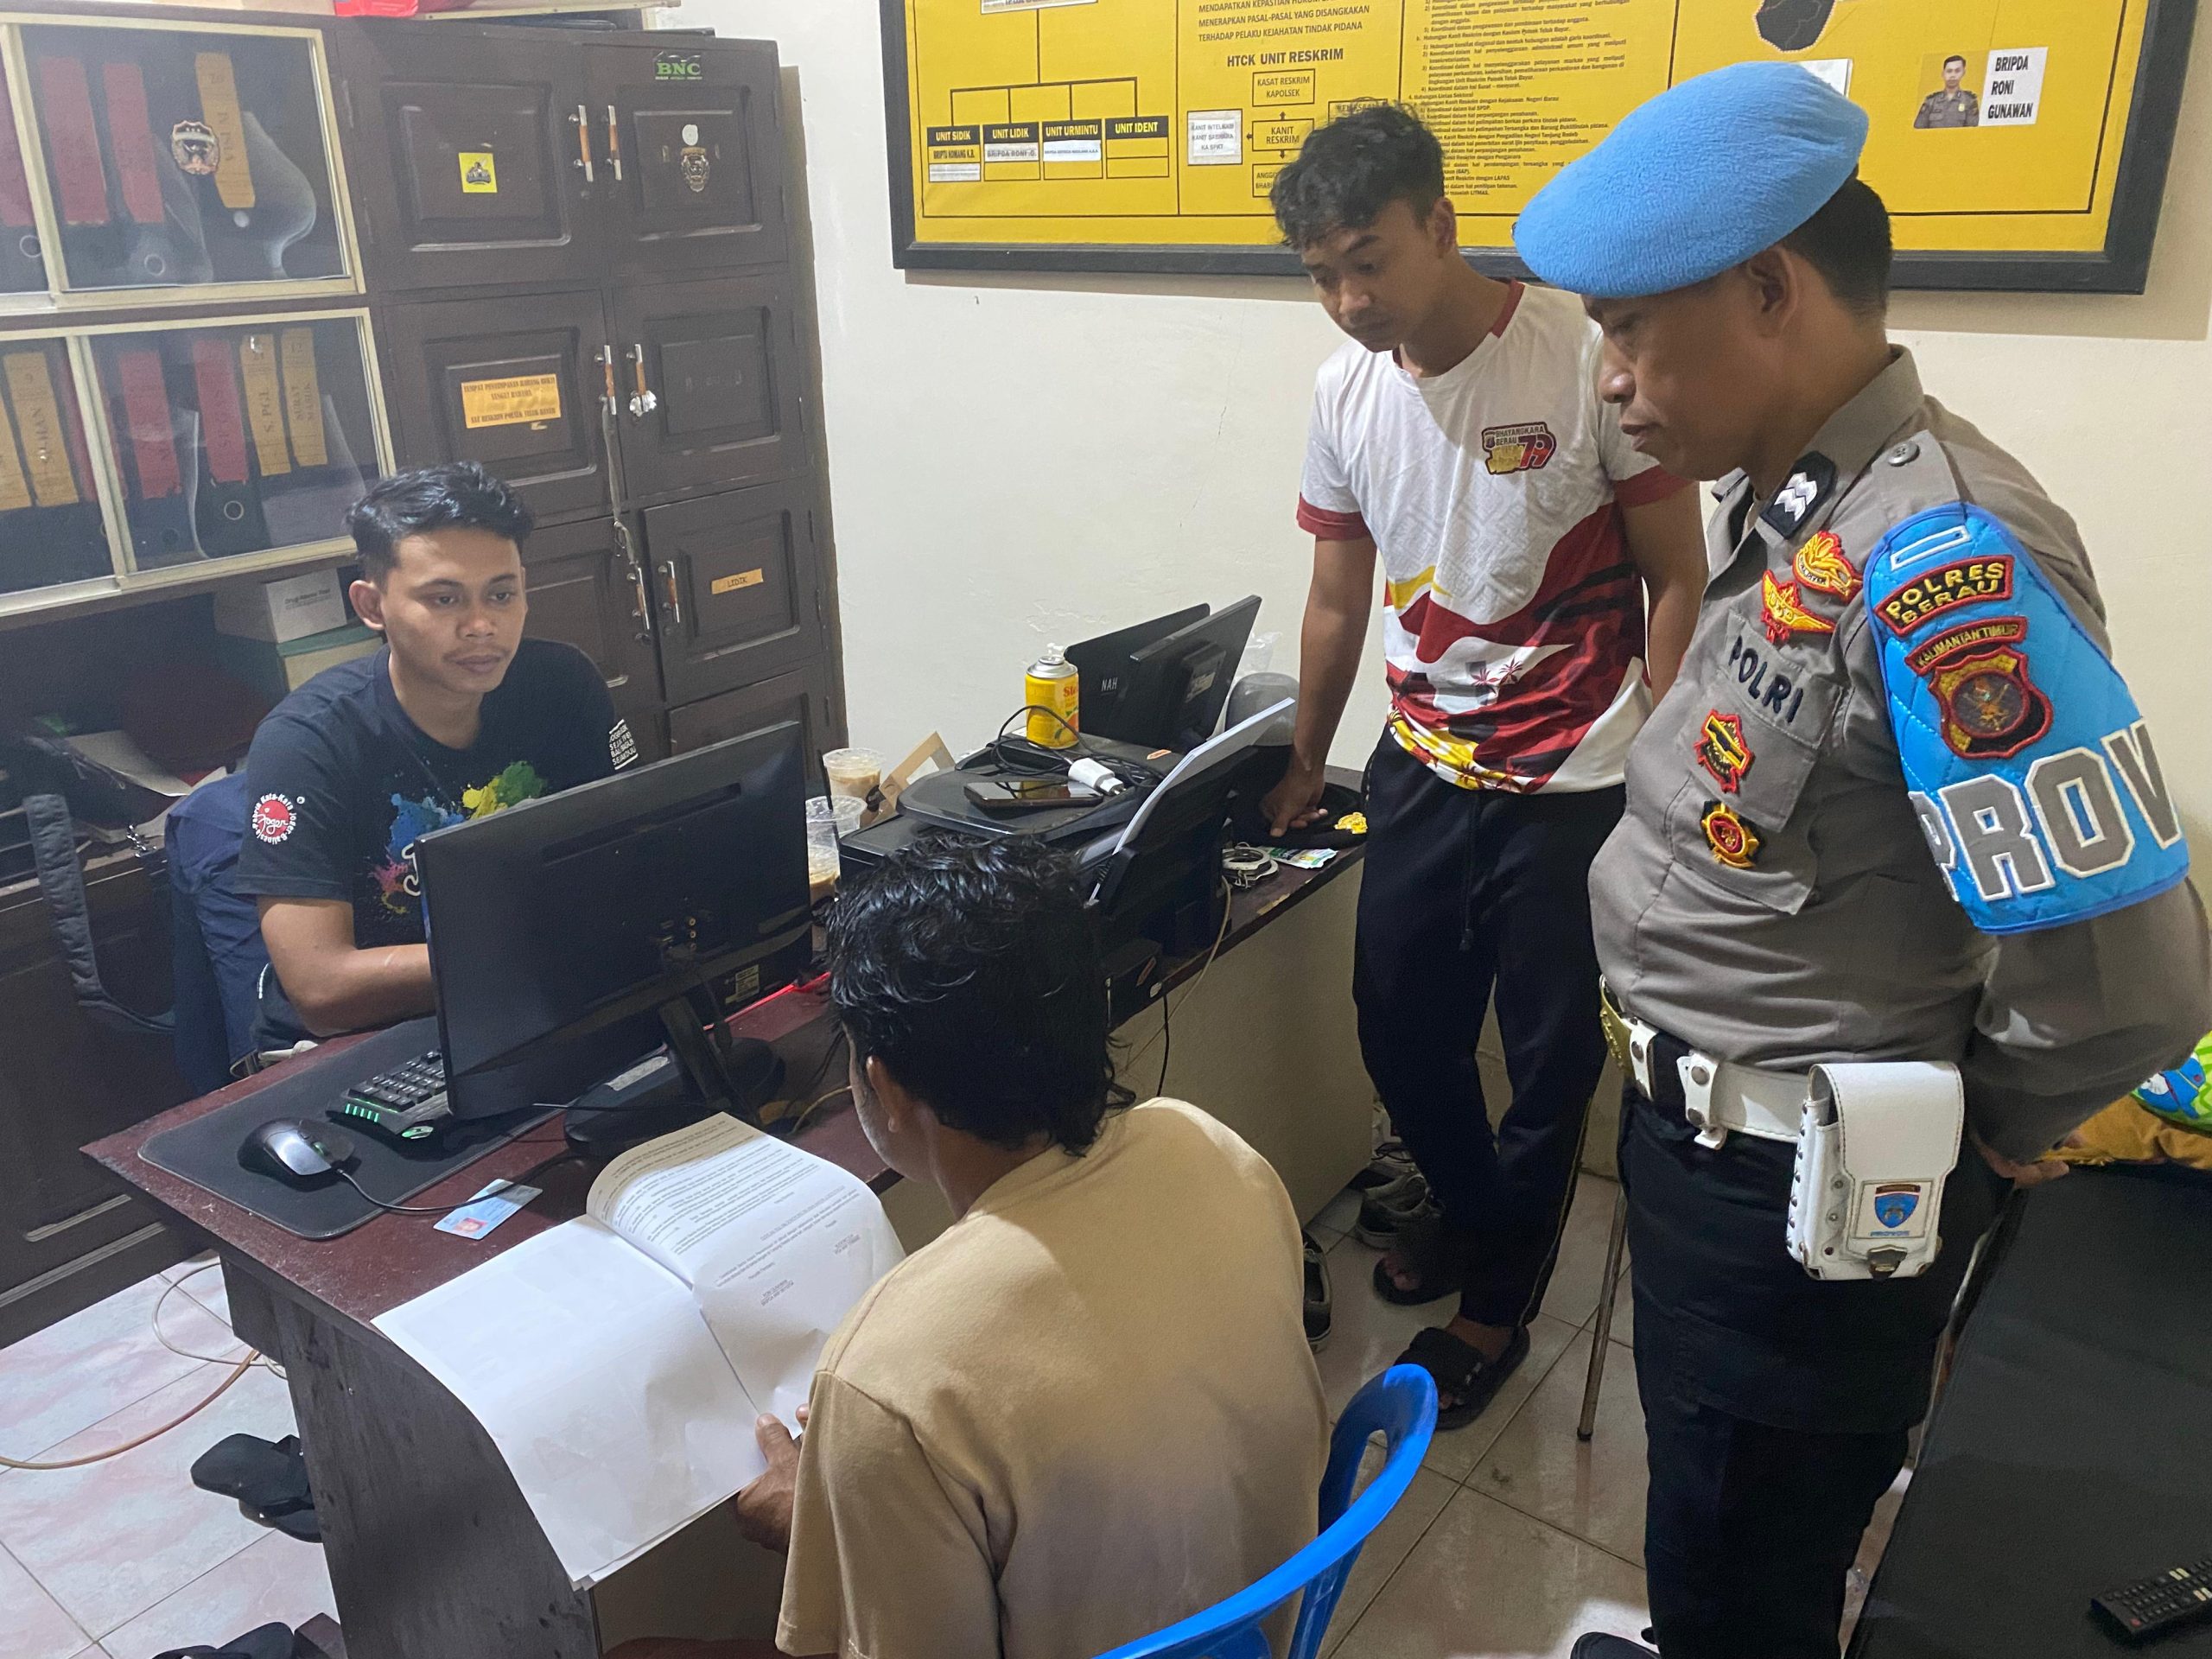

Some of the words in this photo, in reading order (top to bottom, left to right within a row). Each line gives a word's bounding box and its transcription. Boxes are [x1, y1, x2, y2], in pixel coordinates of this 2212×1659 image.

[1199, 17, 1245, 27] MENERAPKAN
[1248, 13, 1292, 23] PASAL-PASAL
[1316, 5, 1370, 17] DISANGKAKAN
[1199, 32, 1234, 42] TERHADAP
[1235, 30, 1261, 38] PELAKU
[1263, 27, 1303, 37] KEJAHATAN
[1305, 24, 1332, 33] TINDAK
[1334, 21, 1362, 31] PIDANA
[1228, 54, 1255, 67] HTCK
[1261, 52, 1286, 64] UNIT
[1289, 48, 1343, 62] RESKRIM
[1995, 55, 2029, 71] BRIPDA
[657, 63, 701, 75] BNC
[1257, 78, 1278, 86] KASAT
[1991, 80, 2014, 95] RONI
[1266, 89, 1300, 98] KAPOLSEK
[1988, 103, 2033, 119] GUNAWAN
[992, 129, 1008, 139] UNIT
[1009, 128, 1029, 138] LIDIK
[1046, 126, 1062, 136] UNIT
[1064, 125, 1098, 135] URMINTU
[1115, 123, 1133, 133] UNIT
[1134, 122, 1158, 132] IDENT
[1271, 127, 1294, 135] KANIT
[936, 133, 951, 142] UNIT
[952, 131, 971, 140] SIDIK
[1266, 135, 1299, 143] RESKRIM
[1496, 426, 1544, 437] BHAYANGKARA
[1518, 433, 1554, 468] 79
[1886, 563, 2004, 620] POLRES
[1902, 580, 1998, 624] BERAU
[1917, 631, 1980, 666] KALIMANTAN
[1101, 677, 1118, 691] NAH
[1729, 636, 1803, 723] POLRI
